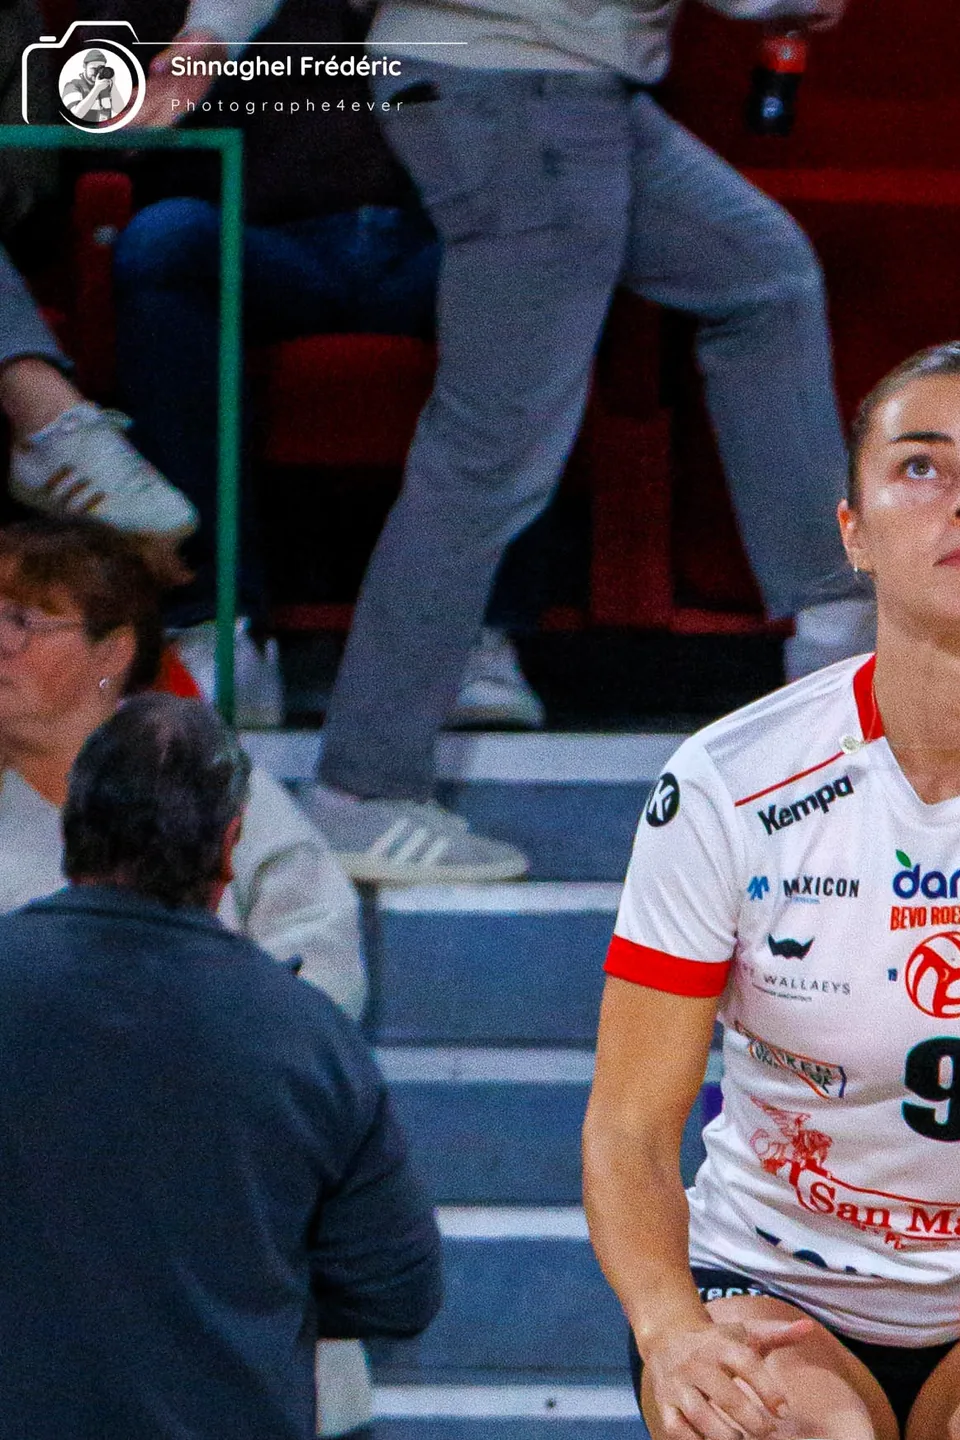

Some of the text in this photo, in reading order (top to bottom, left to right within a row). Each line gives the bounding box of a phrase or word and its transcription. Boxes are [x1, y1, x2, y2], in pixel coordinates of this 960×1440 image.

[757, 775, 855, 835] Kempa
[890, 905, 927, 931] BEVO
[763, 974, 852, 996] WALLAEYS
[809, 1181, 893, 1229] San
